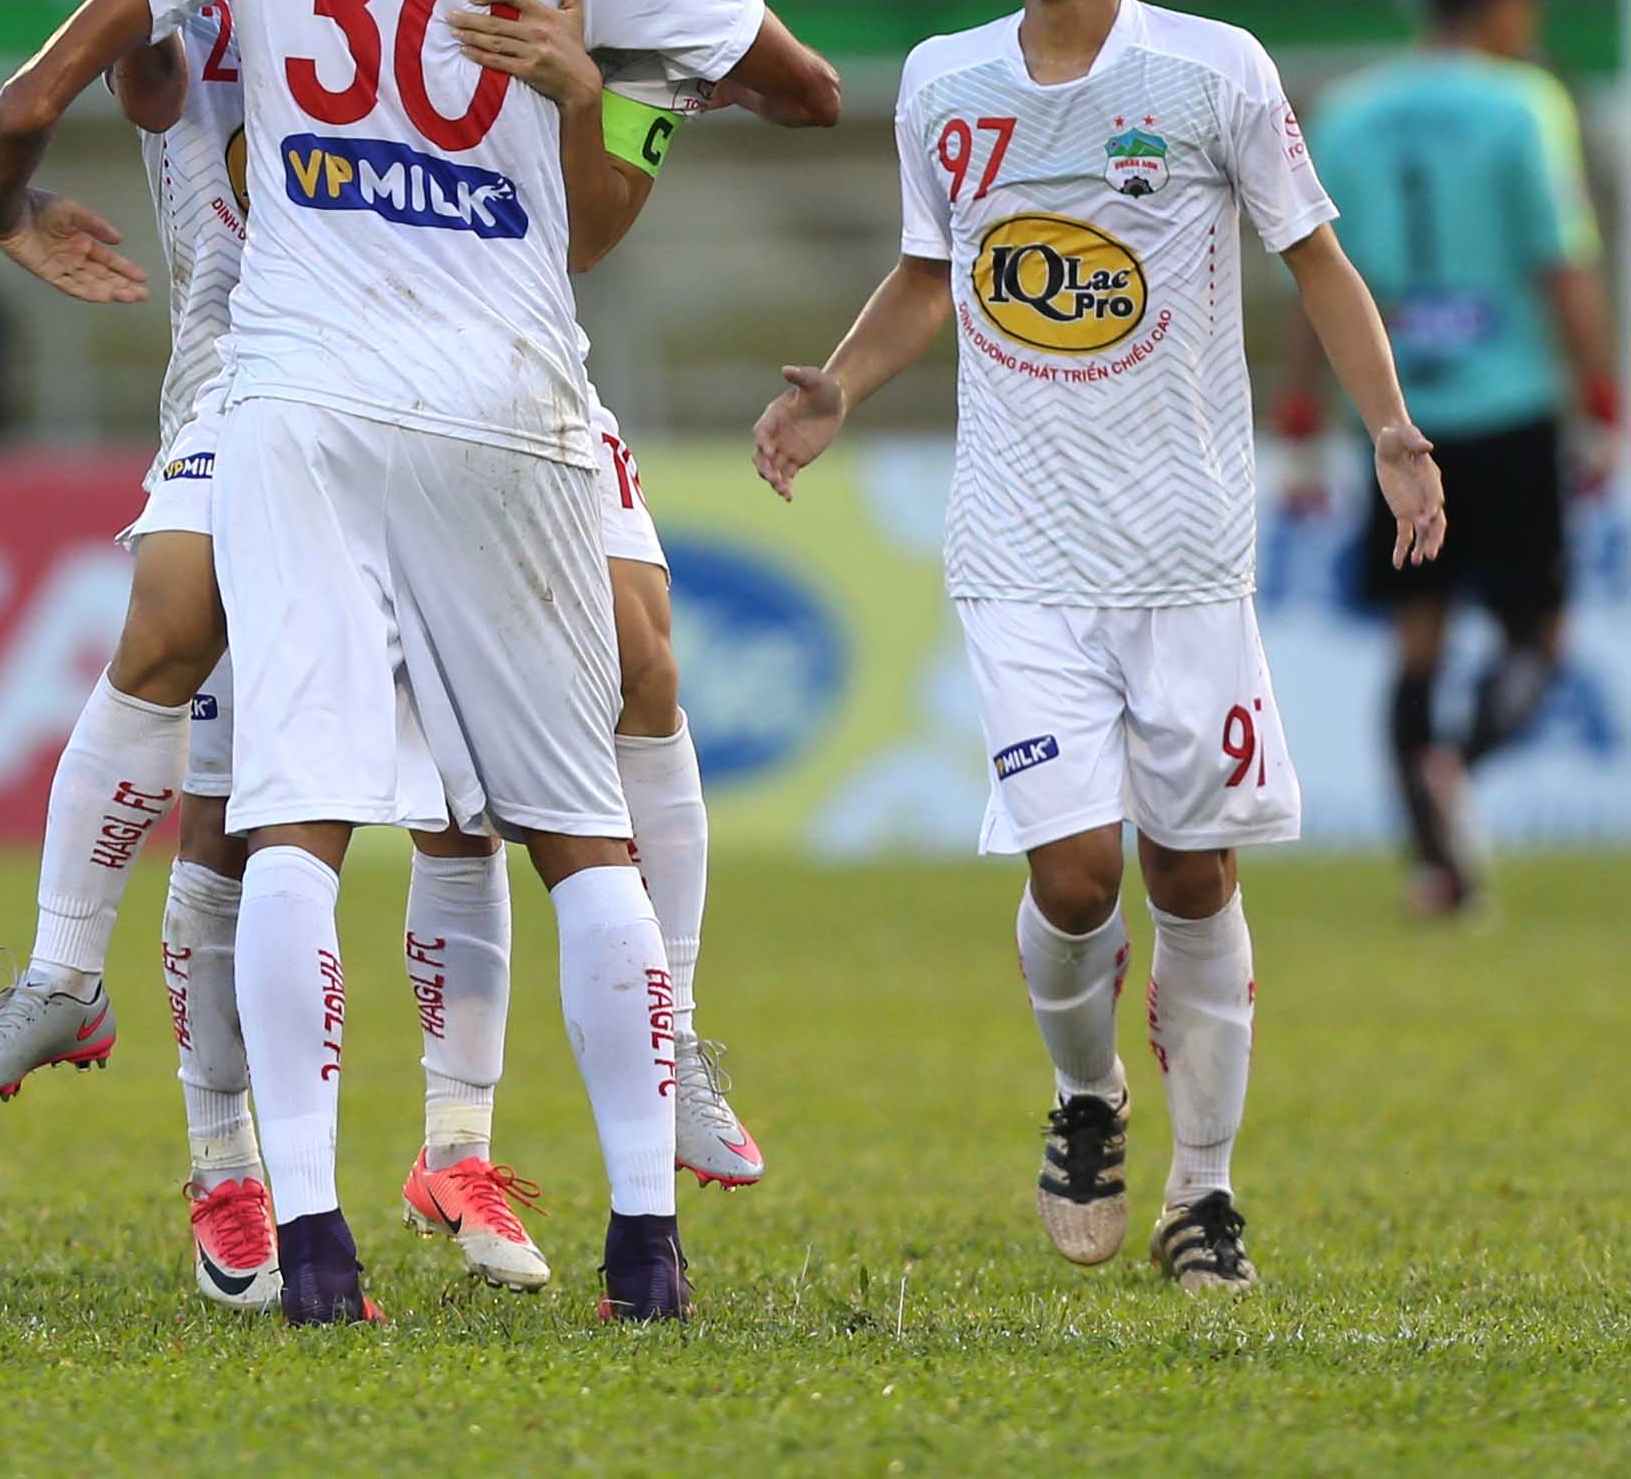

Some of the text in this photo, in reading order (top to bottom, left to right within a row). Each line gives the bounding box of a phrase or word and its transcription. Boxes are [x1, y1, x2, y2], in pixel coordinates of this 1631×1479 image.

[642, 116, 674, 166] C
[938, 116, 1017, 203] 97
[211, 197, 239, 233] DINH
[288, 149, 514, 228] VPMILK
[987, 244, 1132, 321] IQ Lac
[1074, 293, 1134, 319] Pro
[1018, 360, 1059, 382] PHÁT
[1150, 308, 1173, 343] CAO
[89, 780, 173, 869] HAGL FC
[162, 941, 194, 1052] HAGL FC
[406, 930, 446, 1040] HAGL FC
